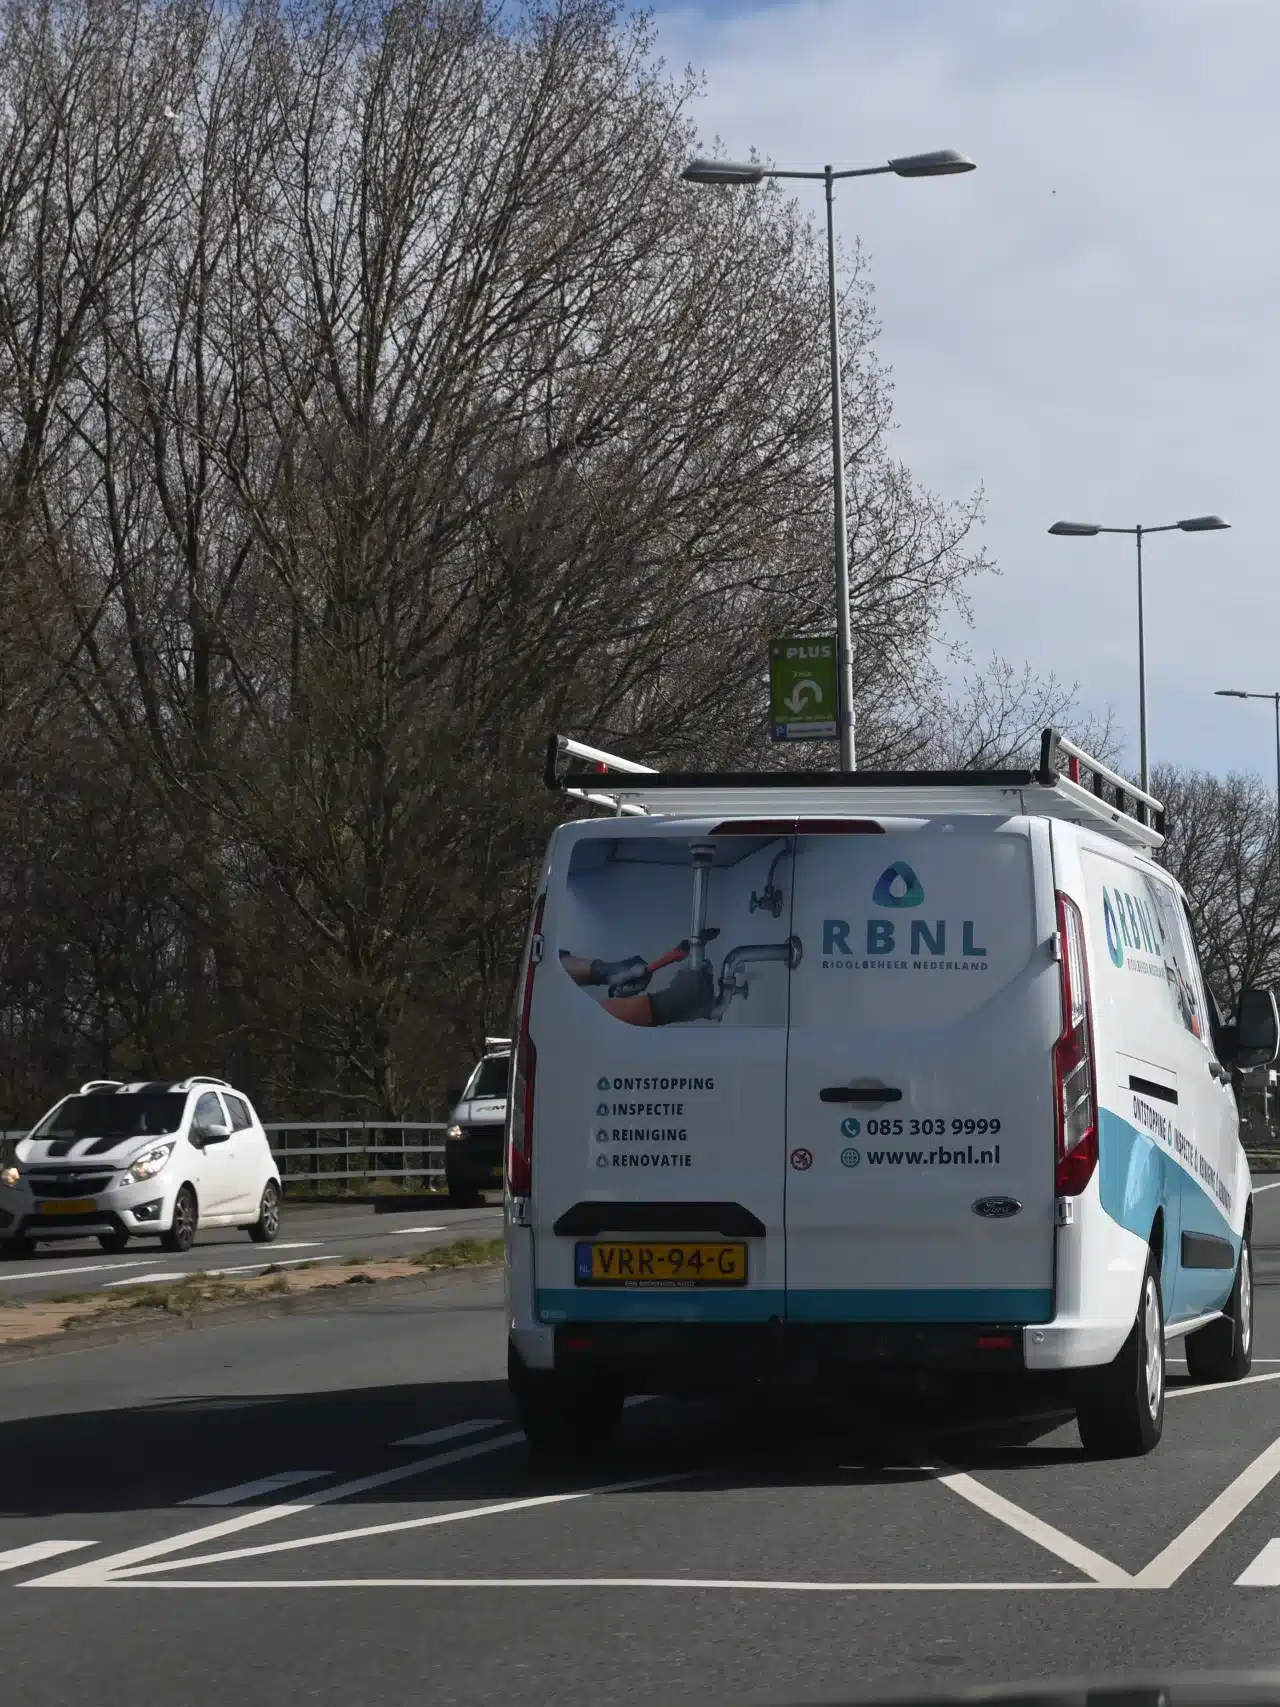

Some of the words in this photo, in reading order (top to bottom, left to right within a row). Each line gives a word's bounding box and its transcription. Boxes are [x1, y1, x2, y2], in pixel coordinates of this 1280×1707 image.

[787, 645, 832, 658] PLUS
[1113, 887, 1161, 956] RBNL
[822, 919, 987, 957] RBNL
[822, 960, 908, 970] RIOOLBEHEER
[913, 961, 988, 971] NEDERLAND
[613, 1078, 715, 1090] ONTSTOPPING
[612, 1103, 684, 1116] INSPECTIE
[867, 1119, 904, 1135] 085
[909, 1119, 946, 1135] 303
[951, 1118, 1001, 1135] 9999
[612, 1129, 687, 1141] REINIGING
[612, 1154, 692, 1167] RENOVATIE
[867, 1145, 1001, 1165] www.rbnl.nl
[597, 1248, 736, 1275] VRR-94-G
[579, 1266, 591, 1274] NL
